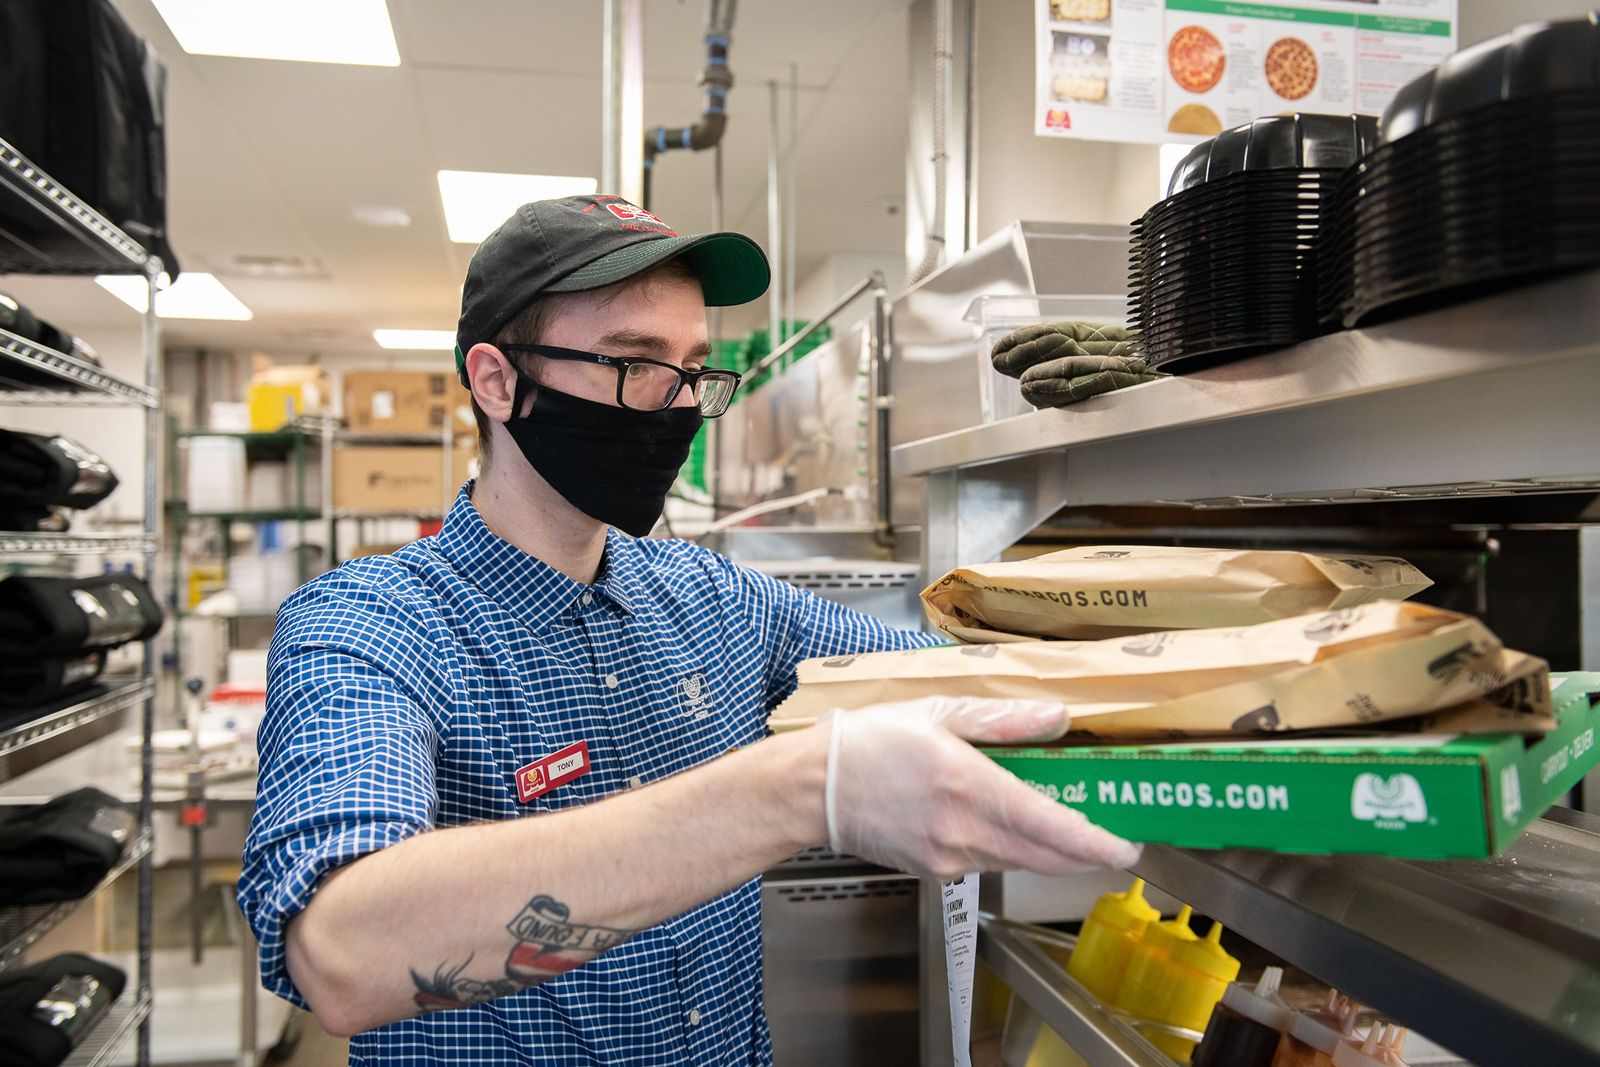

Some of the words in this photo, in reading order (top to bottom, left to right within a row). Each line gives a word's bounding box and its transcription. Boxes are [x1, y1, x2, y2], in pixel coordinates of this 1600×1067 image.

[557, 759, 575, 772] TONY
[1062, 780, 1089, 803] at
[1097, 780, 1289, 811] MARCOS.COM
[950, 898, 964, 912] KNOW
[952, 911, 968, 926] THINK
